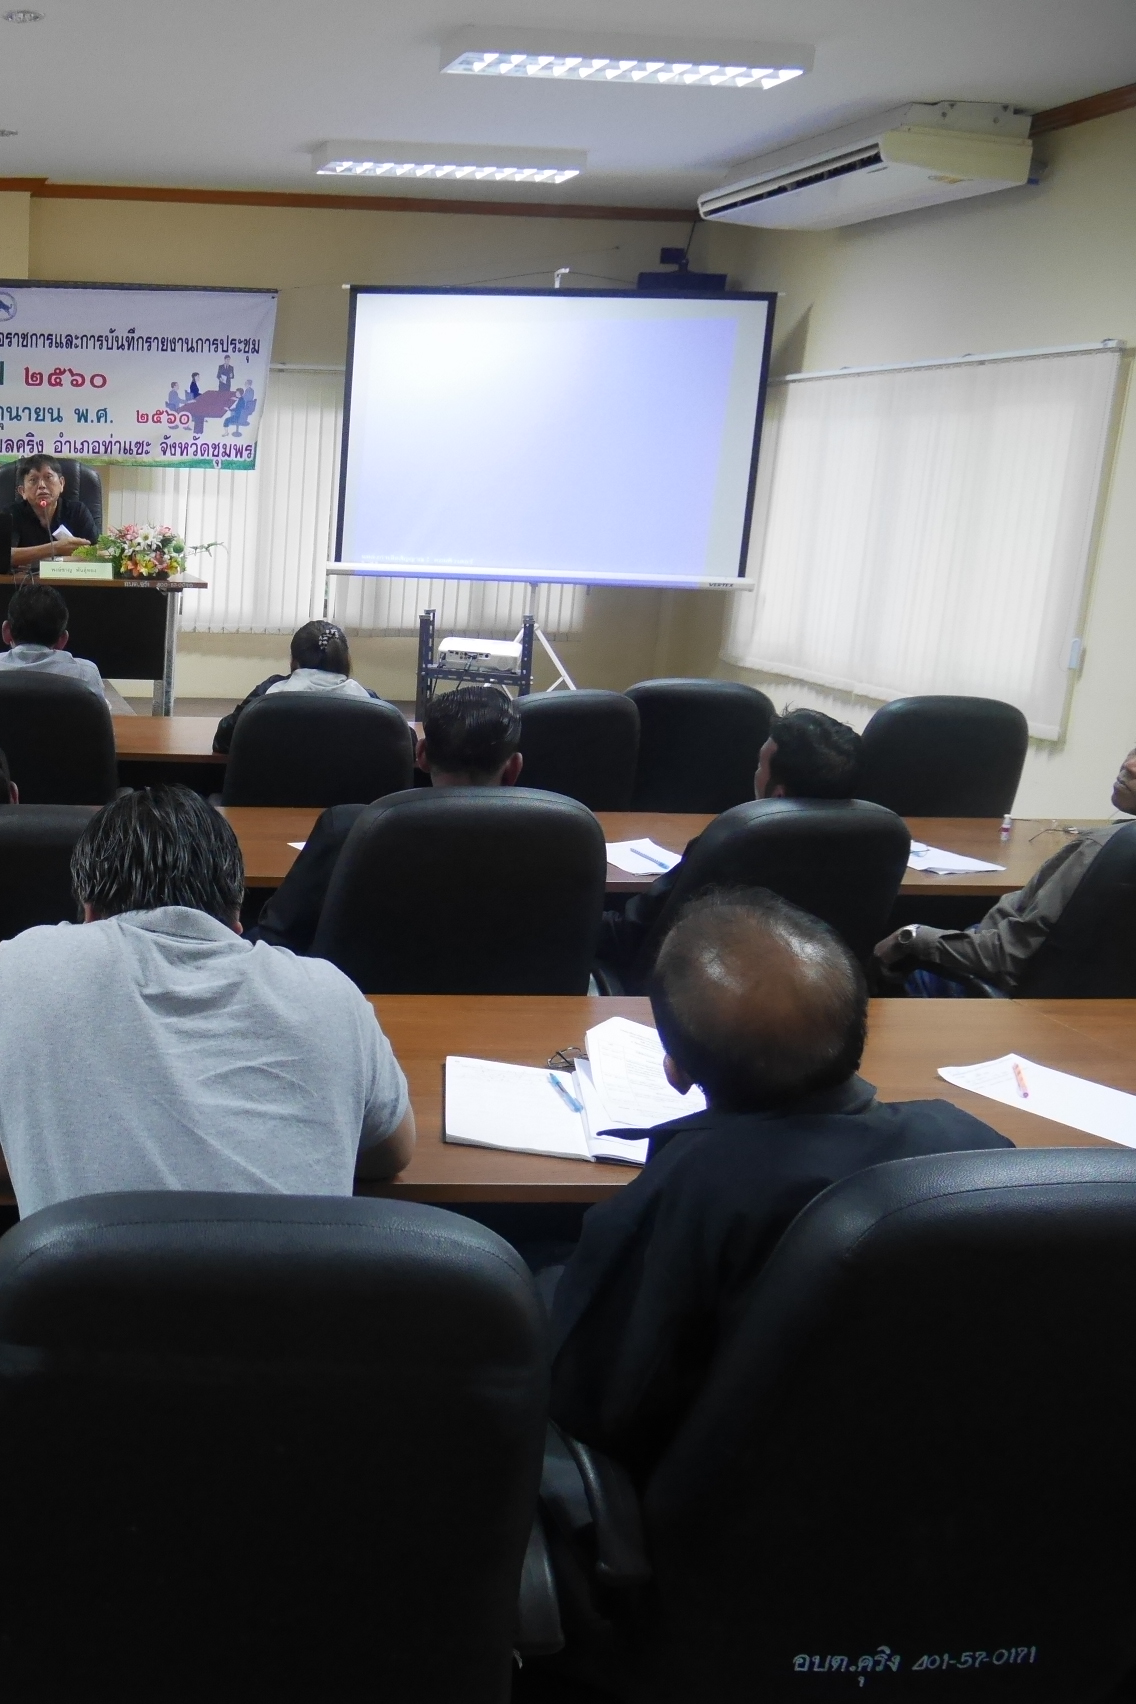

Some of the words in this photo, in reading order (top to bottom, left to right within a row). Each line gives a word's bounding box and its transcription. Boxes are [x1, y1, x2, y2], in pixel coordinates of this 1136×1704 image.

[24, 366, 108, 389] ๒๕๖๐
[74, 406, 114, 424] พ.ศ.
[136, 409, 191, 426] ๒๕๖๐
[54, 432, 152, 456] อำเภอท่าแซะ
[159, 434, 253, 468] จังหวัดชุมพร
[793, 1646, 901, 1687] อบต.คุริง
